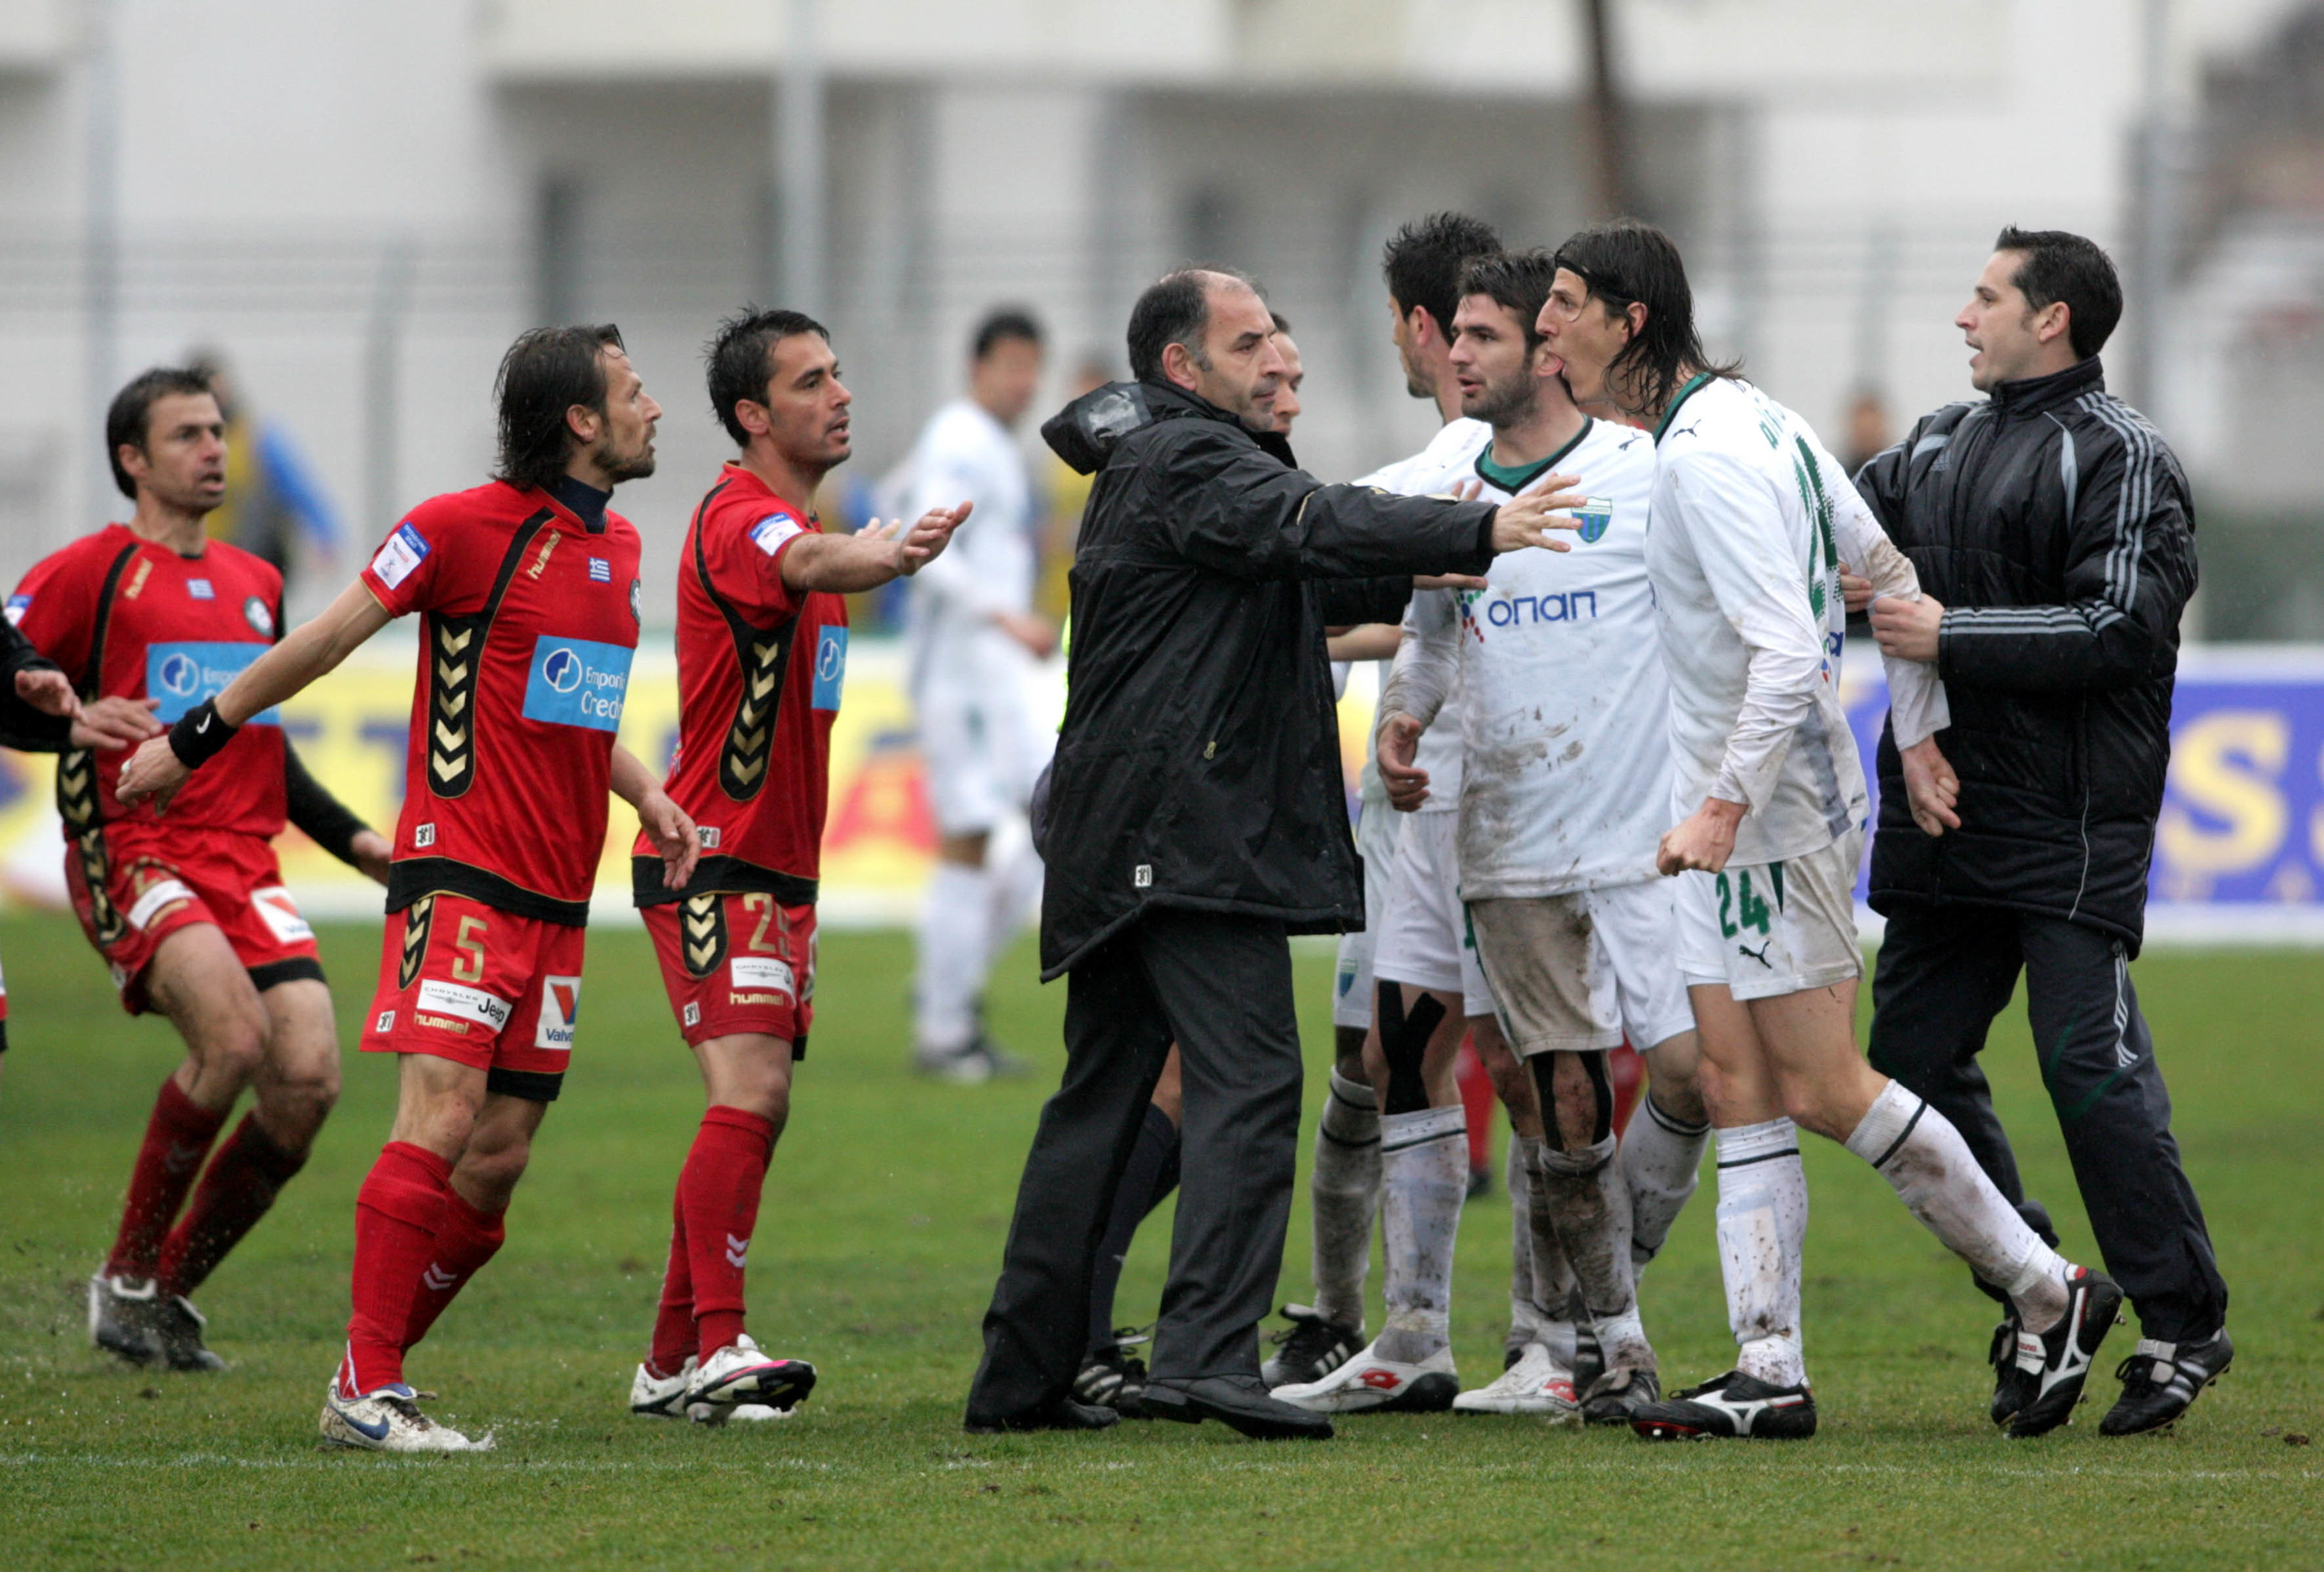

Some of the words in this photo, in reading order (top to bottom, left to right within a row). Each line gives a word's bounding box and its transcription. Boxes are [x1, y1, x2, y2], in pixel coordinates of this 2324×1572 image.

[527, 529, 562, 580] hummel
[1716, 868, 1770, 940] 24
[453, 915, 488, 982] 5
[424, 986, 479, 1001] CHRYSLER
[729, 992, 784, 1005] hummel
[415, 1011, 470, 1035] hummel
[478, 998, 506, 1023] Jeep
